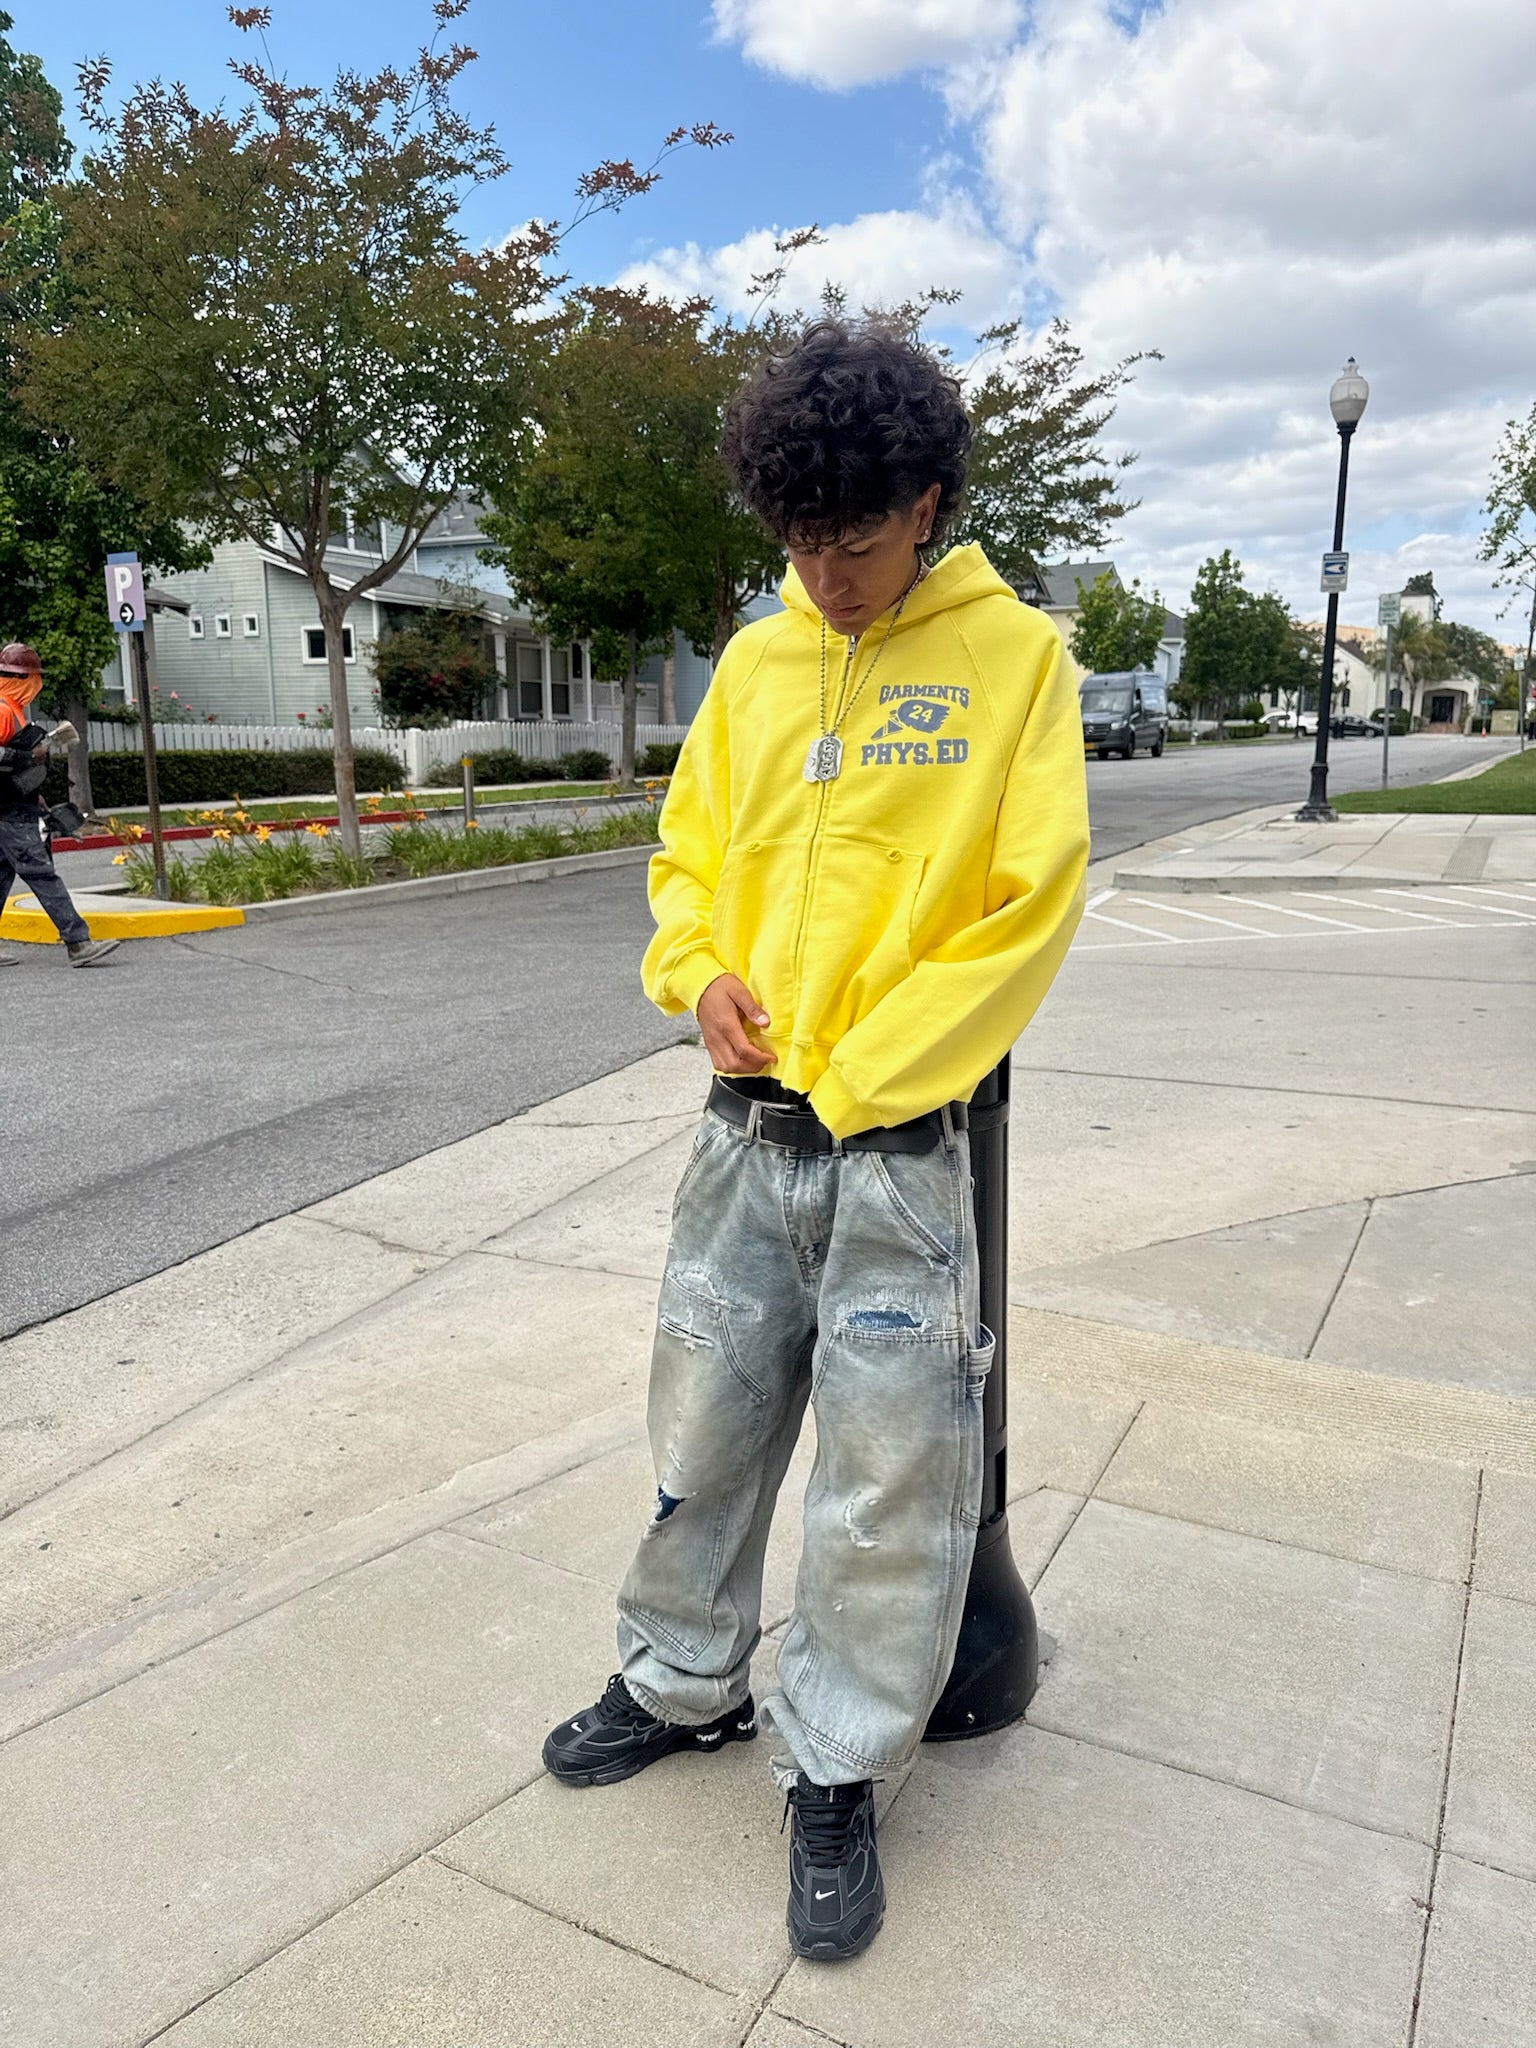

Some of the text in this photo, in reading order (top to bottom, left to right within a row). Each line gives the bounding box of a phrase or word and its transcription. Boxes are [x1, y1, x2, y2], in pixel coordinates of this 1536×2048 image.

[114, 566, 133, 602] P
[879, 685, 969, 709] GARMENTS
[908, 704, 934, 723] 24
